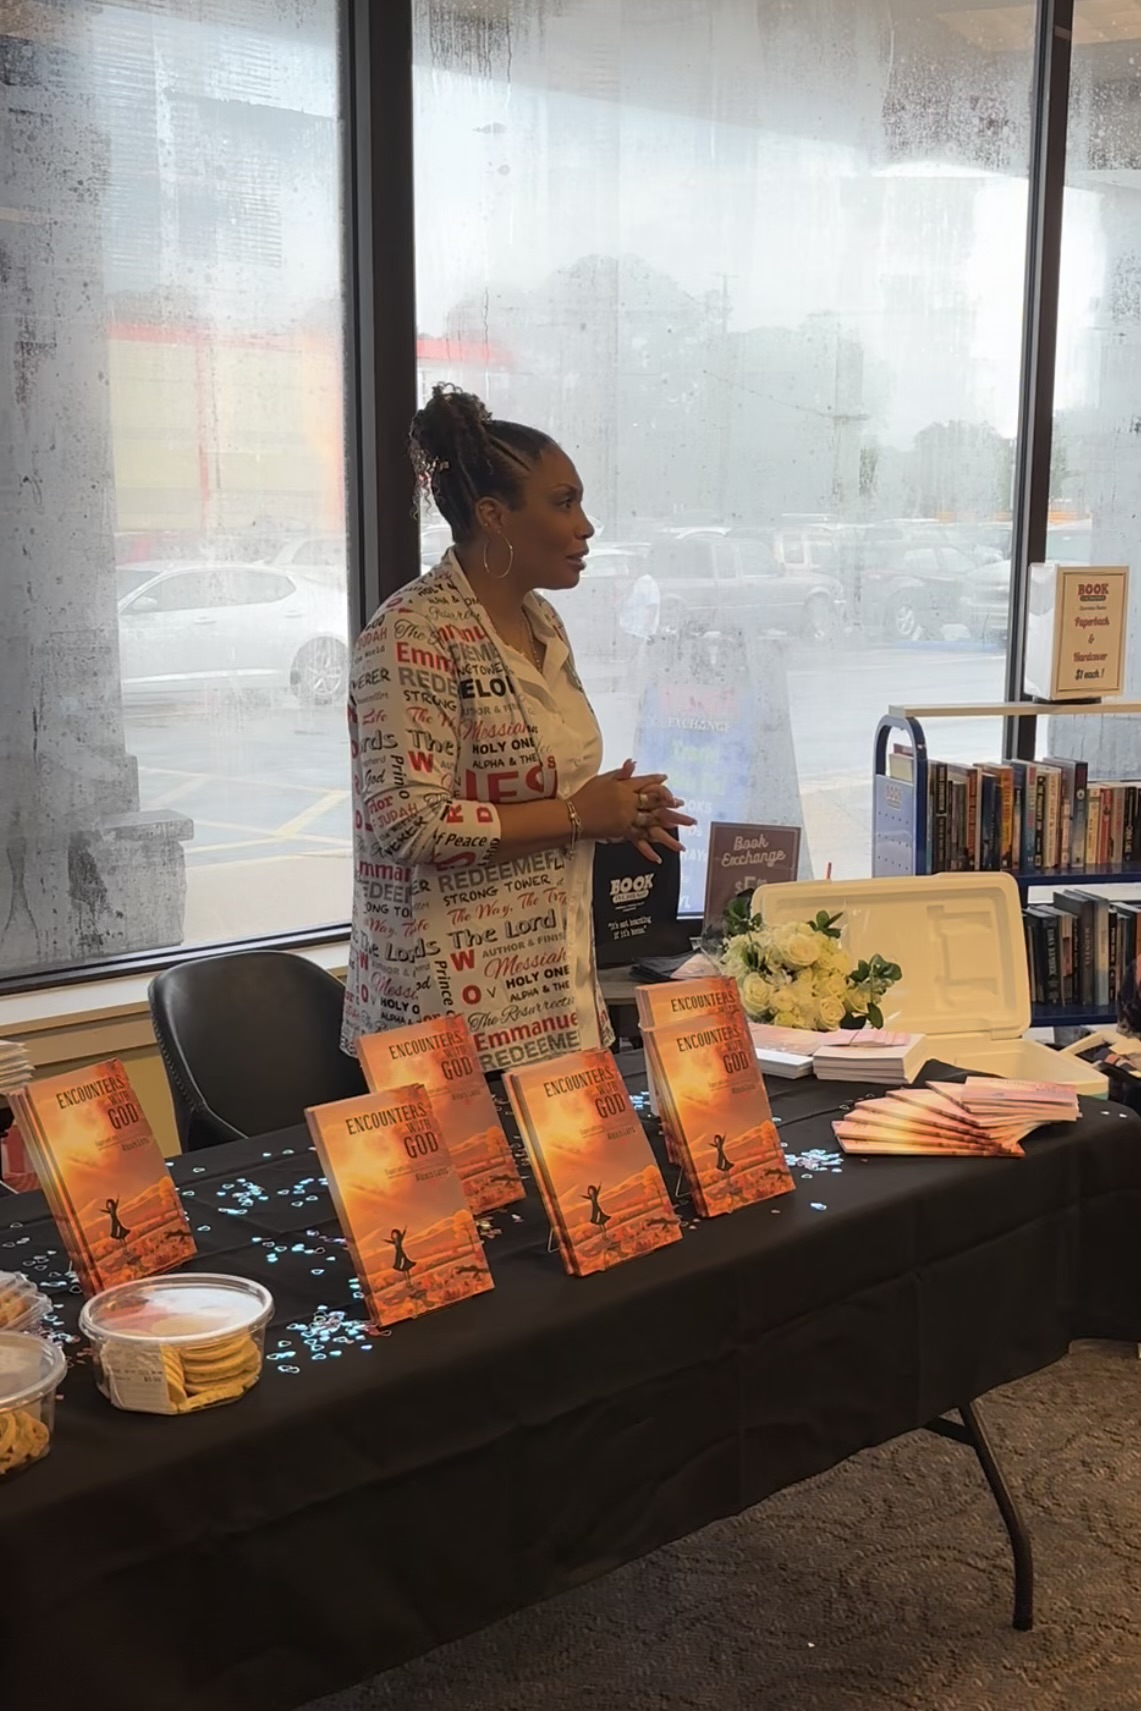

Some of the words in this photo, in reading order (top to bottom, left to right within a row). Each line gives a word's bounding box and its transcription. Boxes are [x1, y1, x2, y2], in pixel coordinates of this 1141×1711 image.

[1078, 583, 1109, 595] BOOK
[1074, 616, 1110, 629] Paperback
[1088, 634, 1095, 644] &
[472, 742, 507, 755] HOLY
[472, 757, 507, 769] ALPHA
[445, 833, 487, 848] Peace
[733, 833, 769, 851] Book
[721, 850, 786, 868] Exchange
[443, 885, 499, 907] STRONG
[504, 873, 550, 893] TOWER
[609, 873, 655, 896] BOOK
[446, 908, 471, 926] The
[517, 890, 537, 909] The
[446, 927, 498, 949] The
[504, 908, 557, 939] Lord
[482, 942, 525, 958] AUTHOR
[528, 938, 535, 947] &
[450, 949, 475, 972] W
[505, 970, 540, 989] HOLY
[544, 965, 570, 979] ONE
[509, 987, 539, 1003] ALPHA
[542, 984, 550, 993] &
[552, 980, 570, 992] THE
[670, 991, 736, 1013] ENCOUNTERS
[380, 997, 409, 1011] HOLY
[467, 1011, 498, 1032] The
[388, 1030, 464, 1060] ENCOUNTERS
[676, 1026, 741, 1052] ENCOUNTERS
[441, 1055, 473, 1081] GOD
[722, 1051, 750, 1074] GOD
[55, 1075, 125, 1110] ENCOUNTERS
[543, 1066, 616, 1098] ENCOUNTERS
[107, 1103, 140, 1130] GOD
[595, 1094, 627, 1119] GOD
[345, 1101, 428, 1136] ENCOUNTERS
[404, 1131, 439, 1159] GOD
